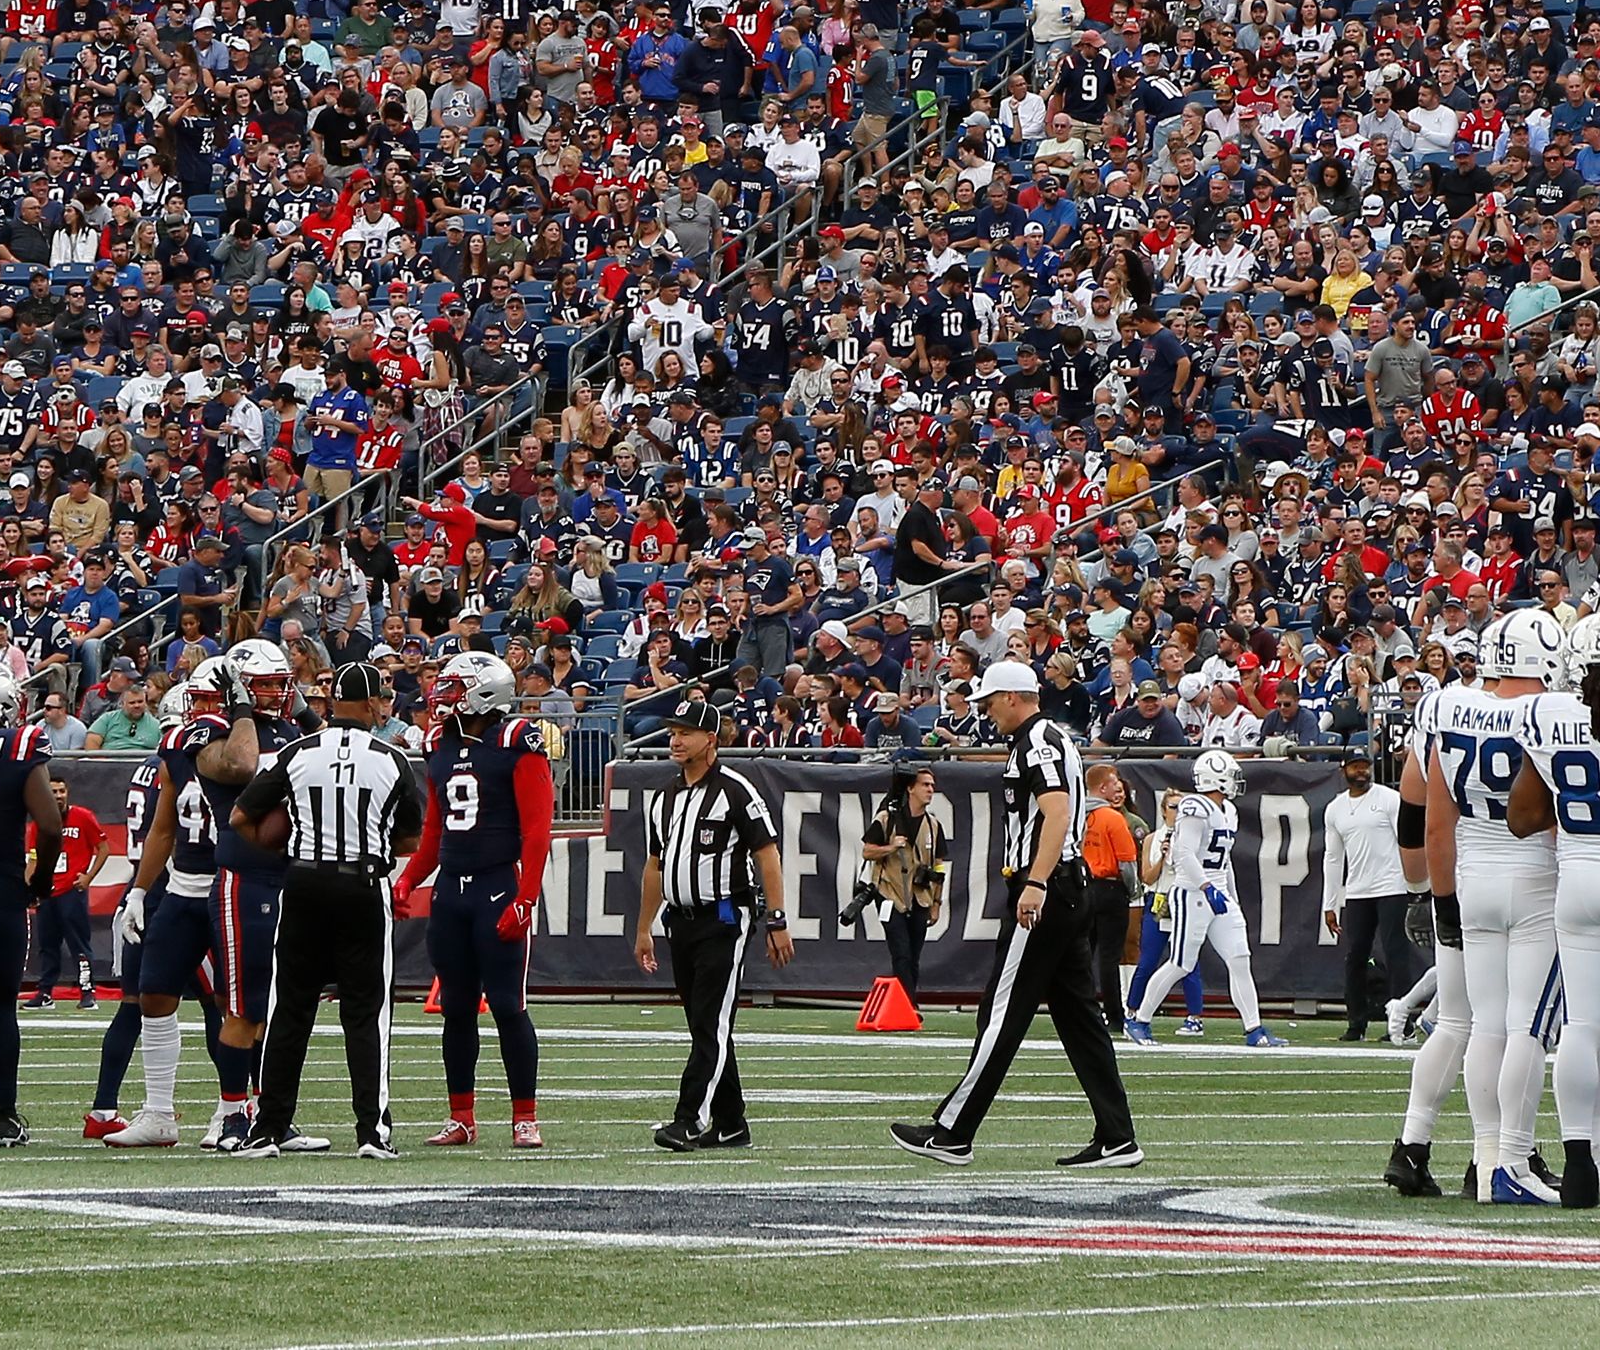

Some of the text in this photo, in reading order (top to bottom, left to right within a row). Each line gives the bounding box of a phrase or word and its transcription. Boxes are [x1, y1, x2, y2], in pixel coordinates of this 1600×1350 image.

[1082, 75, 1097, 100] 9
[1472, 130, 1493, 152] 10
[282, 202, 310, 223] 81
[460, 195, 486, 215] 83
[575, 237, 588, 259] 9
[659, 321, 682, 347] 10
[891, 320, 914, 346] 10
[941, 312, 962, 336] 10
[743, 324, 770, 350] 54
[837, 339, 859, 365] 10
[381, 366, 402, 379] PATS
[1061, 367, 1078, 390] 11
[1319, 383, 1341, 406] 11
[1438, 417, 1470, 443] 24
[359, 441, 380, 469] 11
[700, 462, 722, 484] 12
[1518, 489, 1556, 520] 54
[1056, 504, 1072, 531] 9
[1452, 705, 1514, 732] RAIMANN
[337, 747, 350, 760] U
[1035, 748, 1053, 760] 19
[330, 762, 355, 784] 11
[1441, 736, 1524, 820] 79
[446, 775, 479, 830] 9
[1181, 800, 1199, 815] 57
[866, 977, 890, 1023] 10
